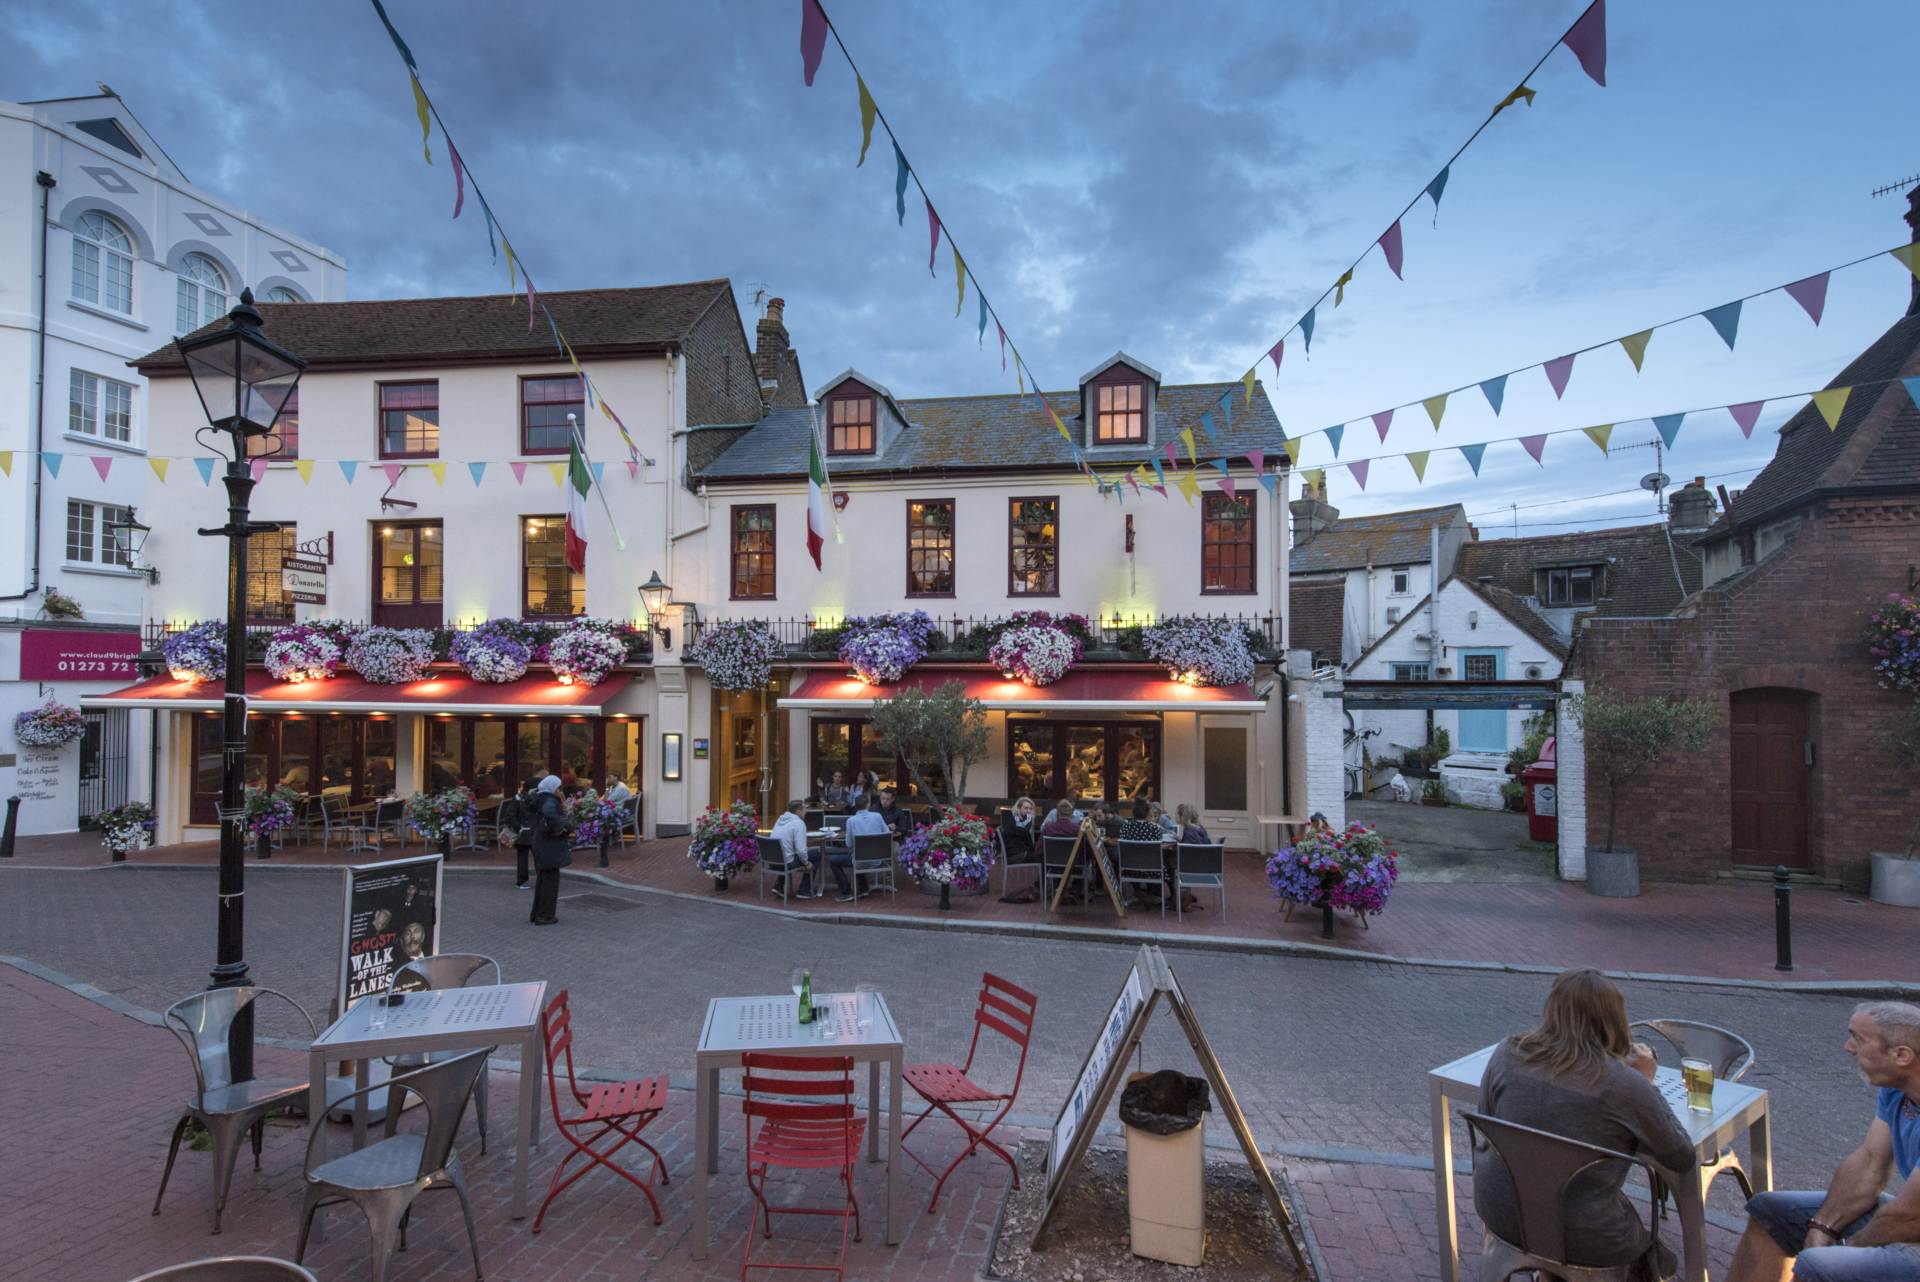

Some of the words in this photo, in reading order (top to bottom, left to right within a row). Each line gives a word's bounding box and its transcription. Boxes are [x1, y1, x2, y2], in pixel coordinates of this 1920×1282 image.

[286, 561, 322, 572] RISTORANTE
[287, 573, 324, 588] Donatello
[291, 593, 317, 601] PIZZERIA
[60, 651, 141, 660] www.cloud9bright
[58, 661, 105, 671] 01273
[111, 662, 129, 671] 72
[351, 933, 396, 954] GHOST
[351, 947, 394, 972] WALK
[357, 968, 370, 981] OF
[370, 964, 387, 977] THE
[350, 973, 393, 998] LANES
